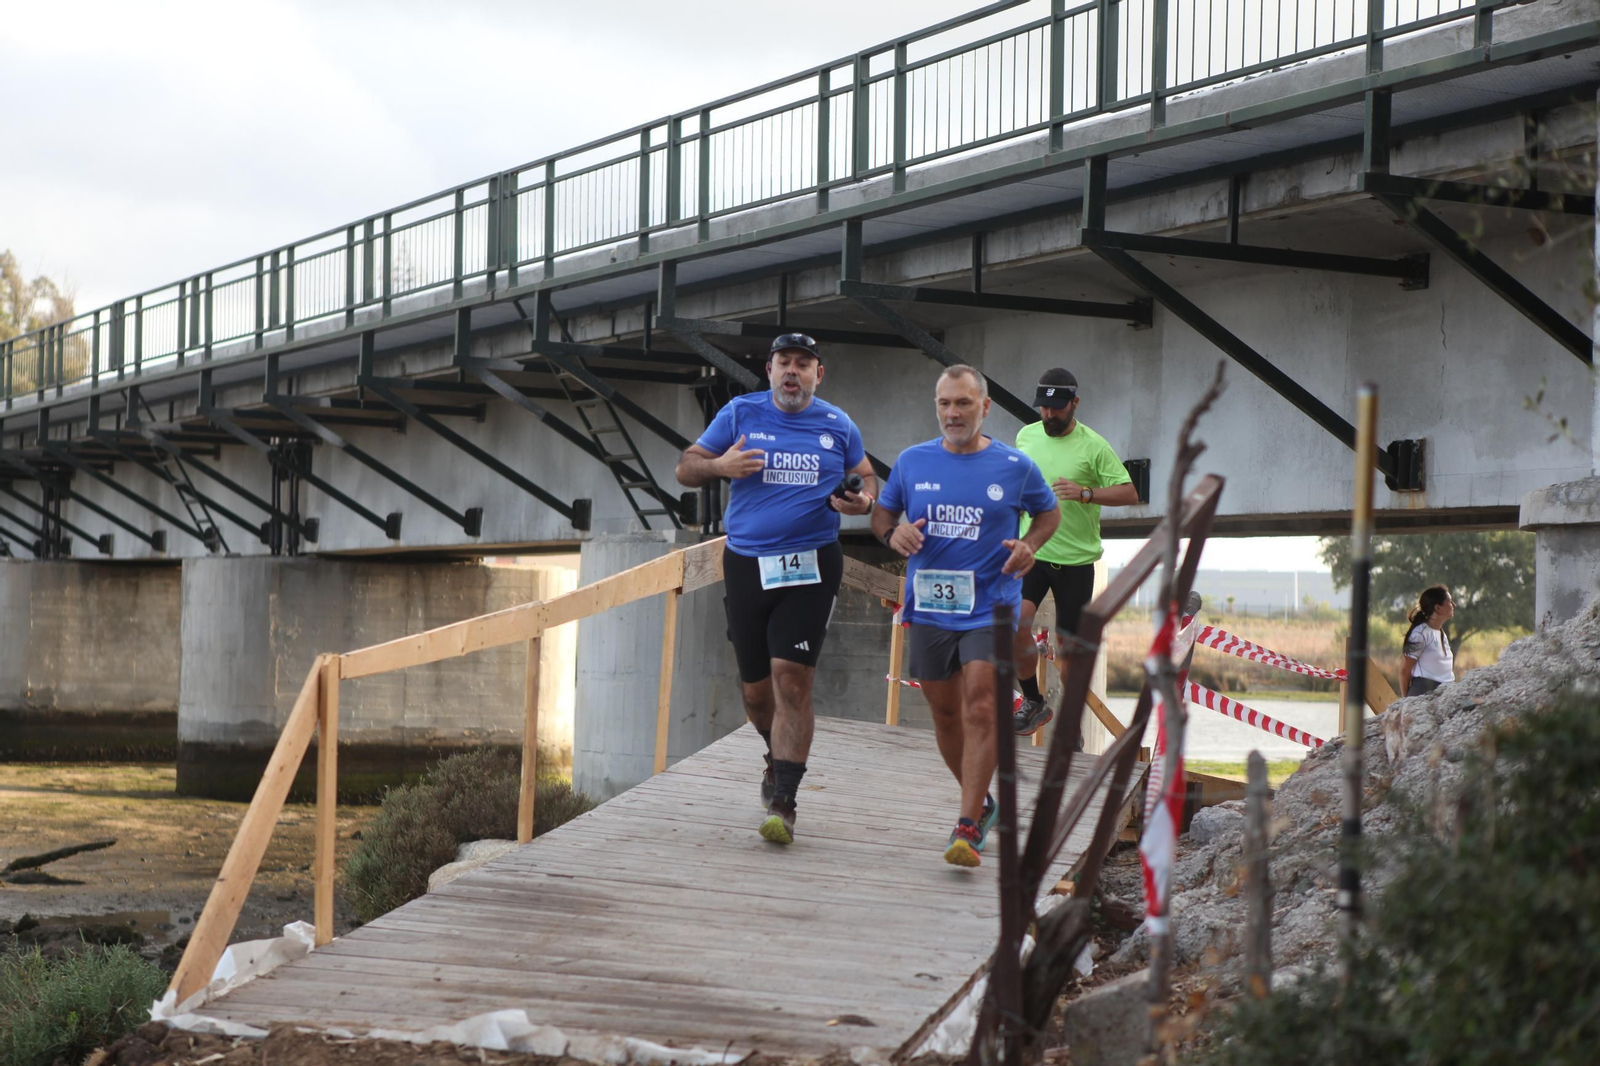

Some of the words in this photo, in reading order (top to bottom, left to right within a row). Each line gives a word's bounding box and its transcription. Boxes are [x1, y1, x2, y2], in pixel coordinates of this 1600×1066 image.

[773, 452, 820, 471] CROSS
[765, 470, 816, 484] INCLUSIVO
[936, 504, 984, 525] CROSS
[929, 523, 977, 539] INCLUSIVO
[778, 553, 801, 571] 14
[933, 583, 955, 600] 33
